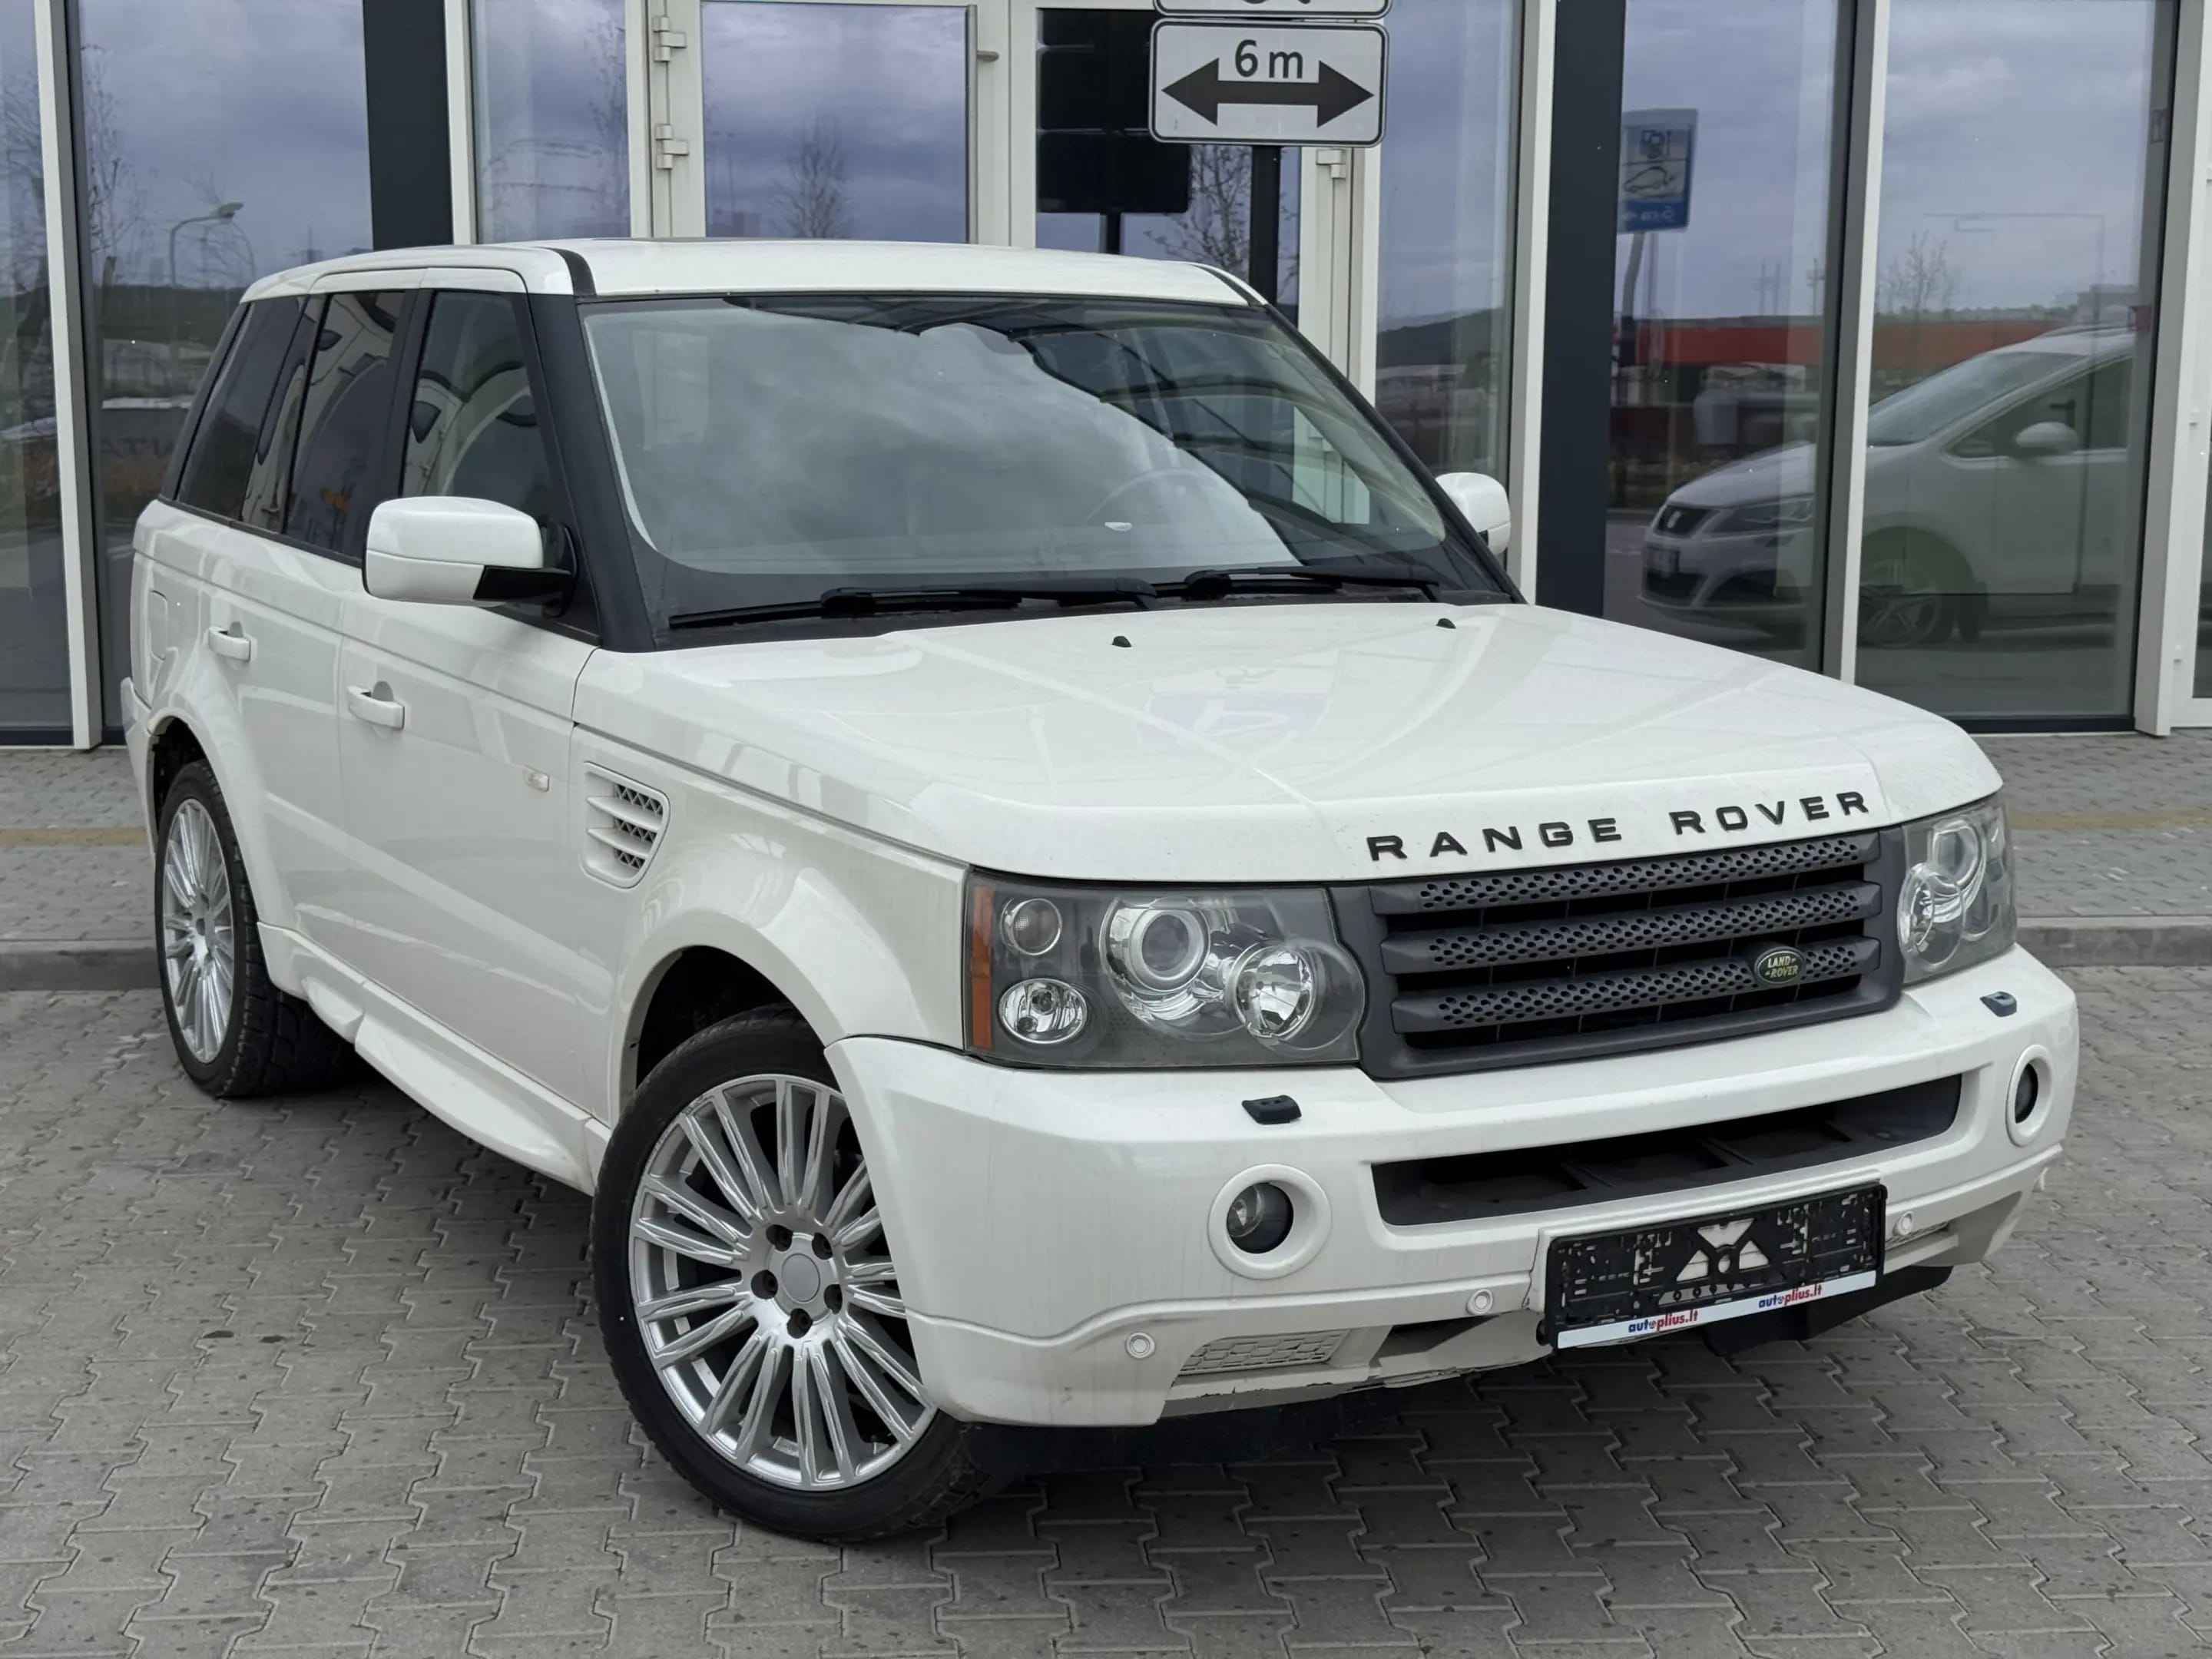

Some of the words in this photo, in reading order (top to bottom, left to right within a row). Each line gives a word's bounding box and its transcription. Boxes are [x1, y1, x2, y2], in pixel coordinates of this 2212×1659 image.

[1235, 39, 1258, 78] 6
[1269, 51, 1303, 79] m
[1366, 817, 1622, 861] RANGE
[1668, 791, 1869, 835] ROVER
[1767, 955, 1791, 969] LAND
[1770, 965, 1799, 979] ROVER
